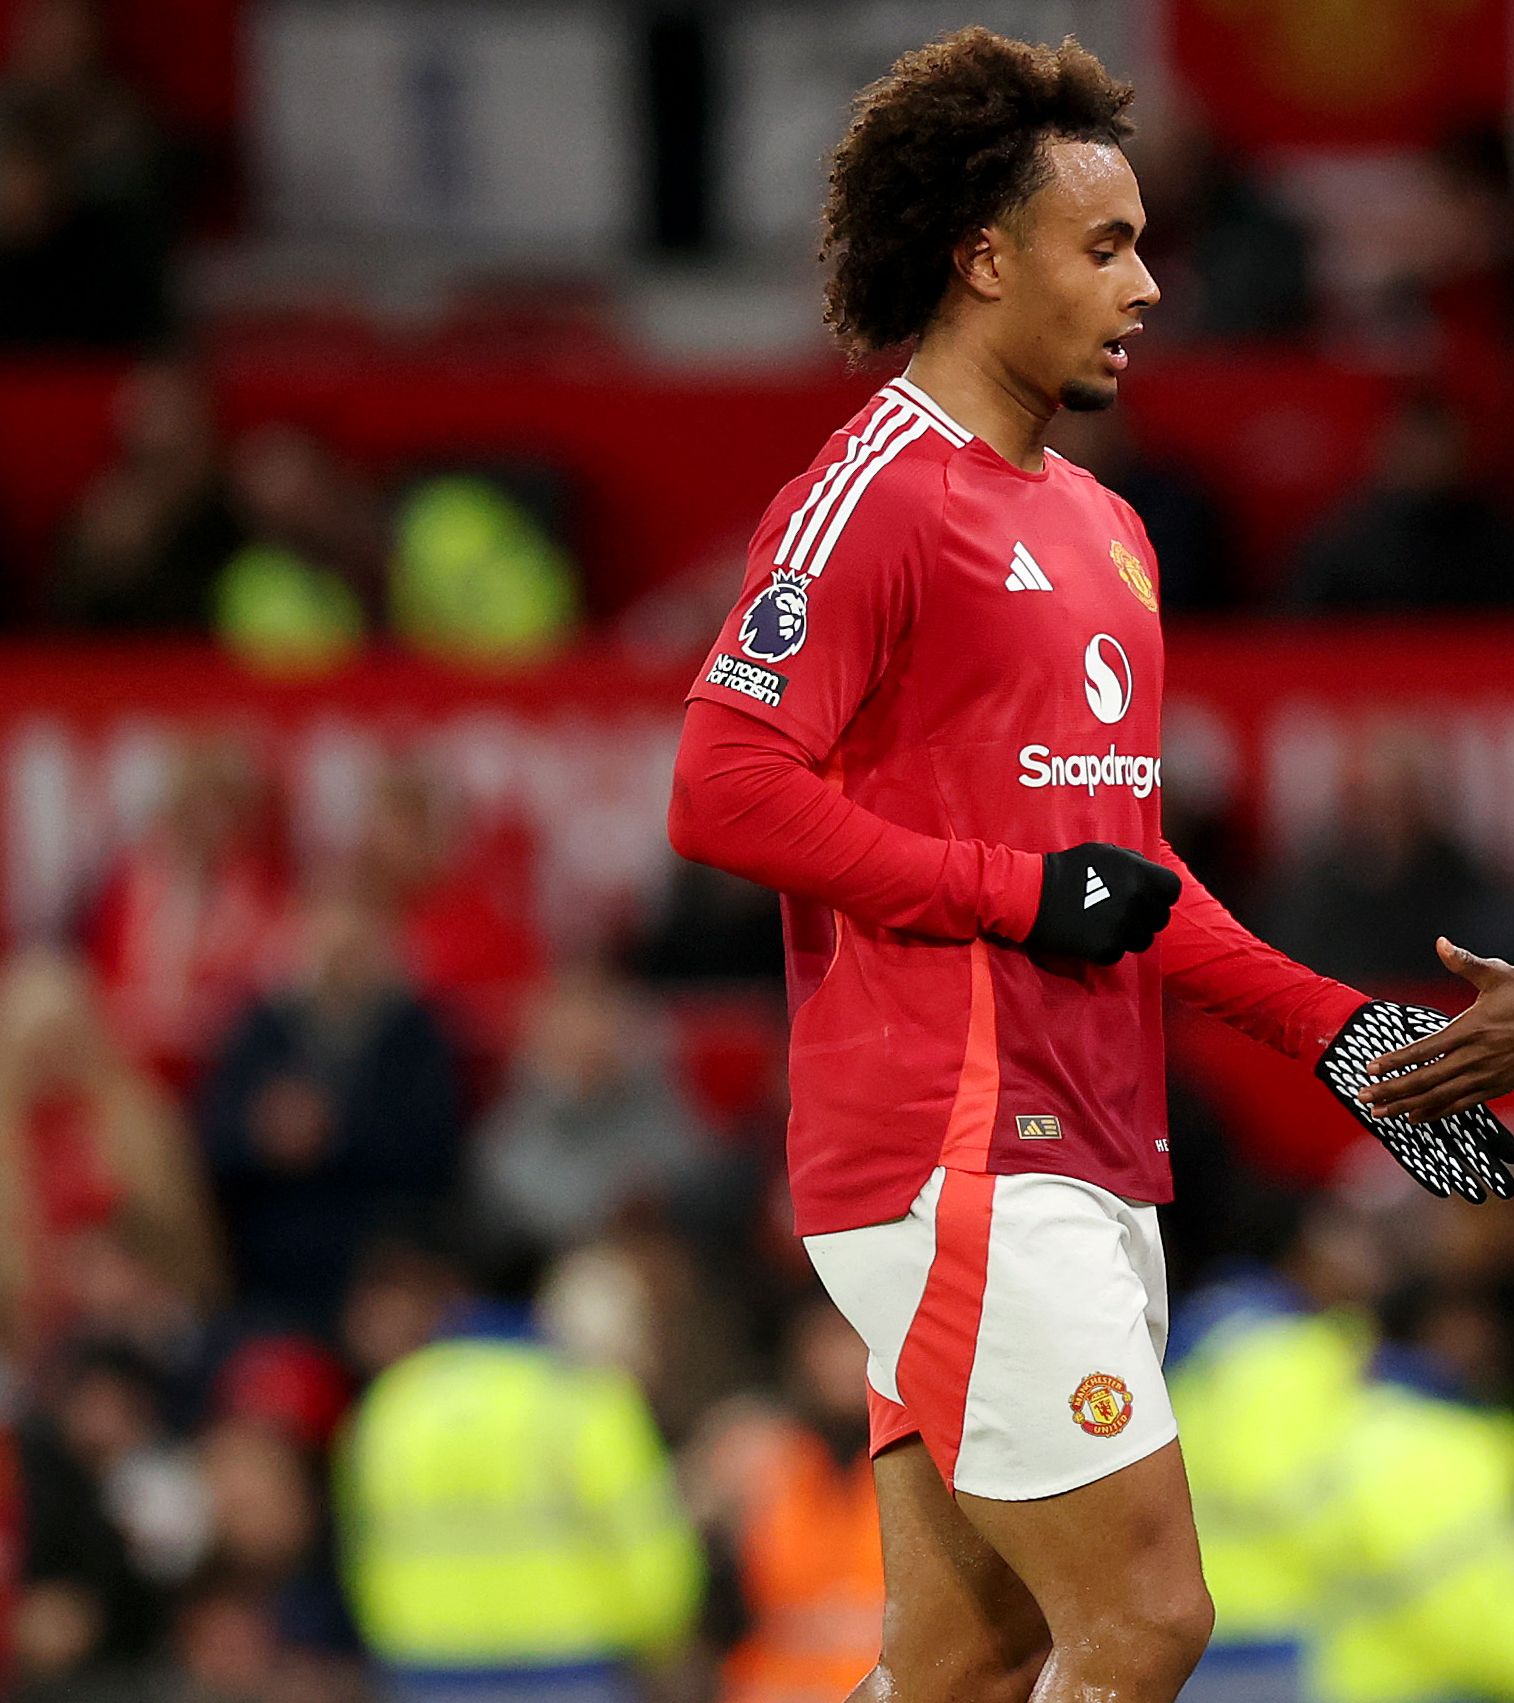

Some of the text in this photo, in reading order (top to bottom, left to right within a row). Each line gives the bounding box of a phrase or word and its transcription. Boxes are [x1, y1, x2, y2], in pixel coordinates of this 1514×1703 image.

[706, 667, 781, 707] for racism
[714, 653, 779, 690] No room
[1093, 1413, 1128, 1434] UNITED
